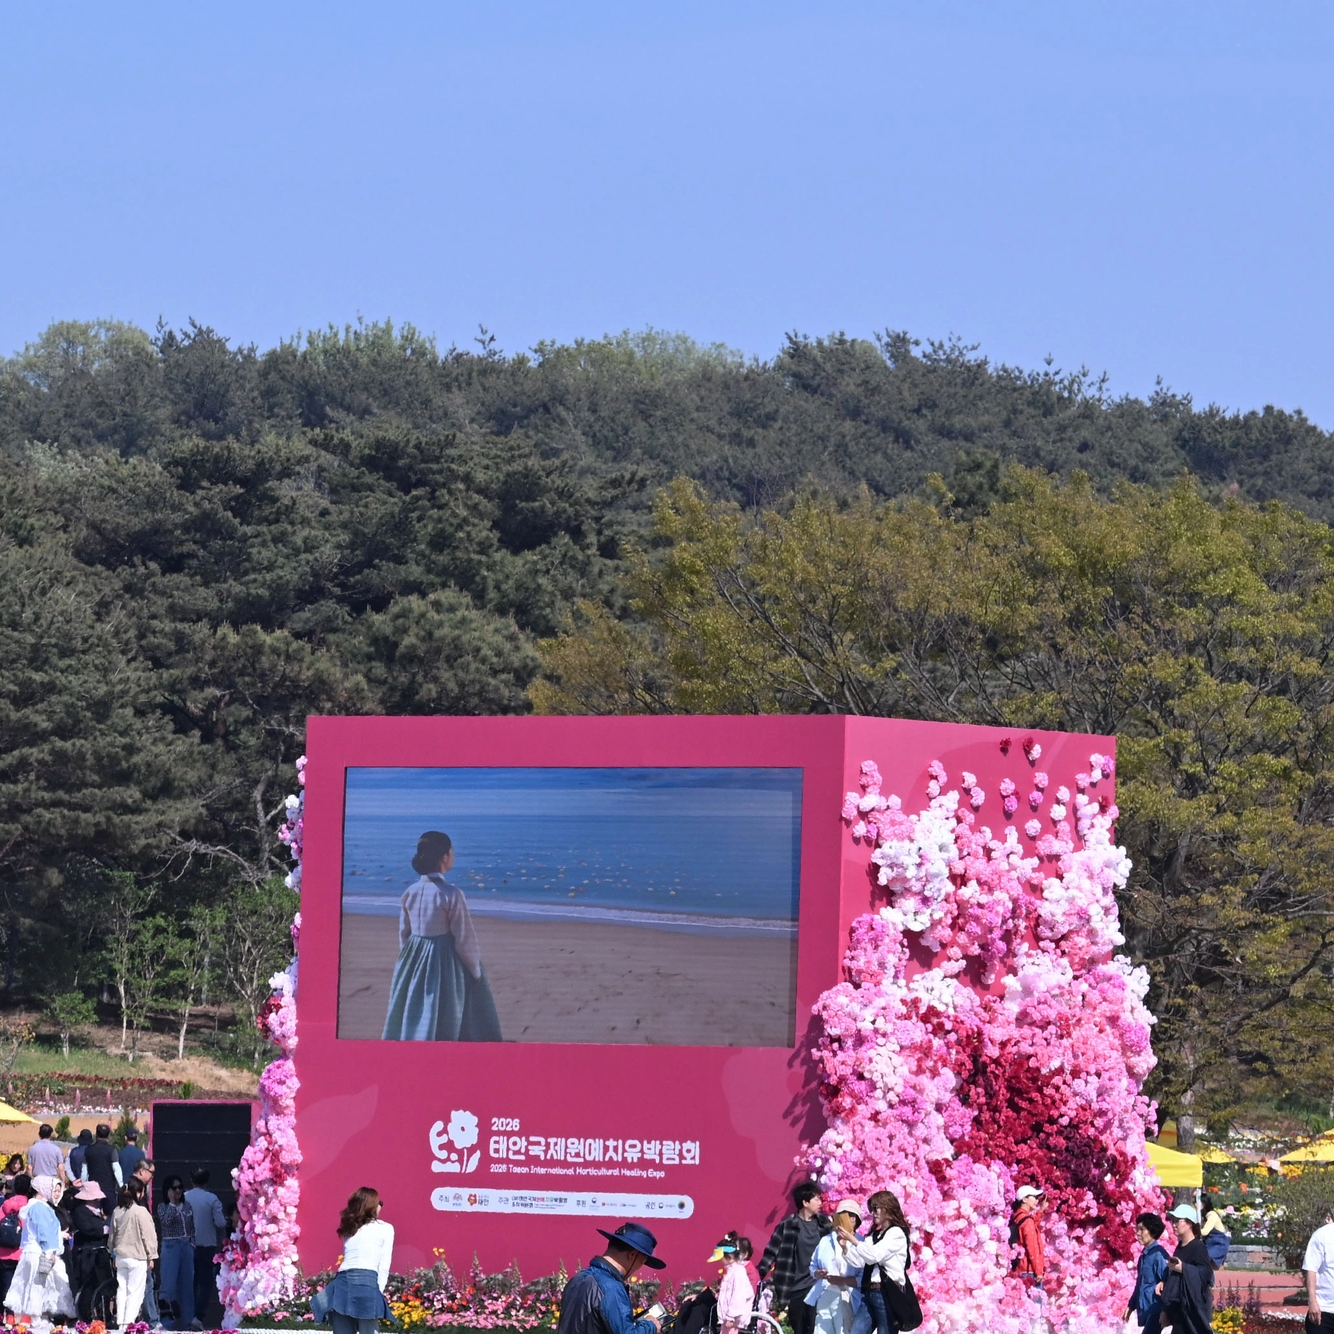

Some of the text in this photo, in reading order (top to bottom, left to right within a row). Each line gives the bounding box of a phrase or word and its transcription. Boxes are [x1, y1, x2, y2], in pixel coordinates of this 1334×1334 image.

[491, 1117, 520, 1131] 2026
[489, 1135, 700, 1165] 태안국제원예치유박람회
[490, 1163, 508, 1173] 2026
[530, 1165, 575, 1175] International
[576, 1166, 620, 1176] Horticultural
[621, 1168, 647, 1178] Healing
[647, 1168, 665, 1180] Expo
